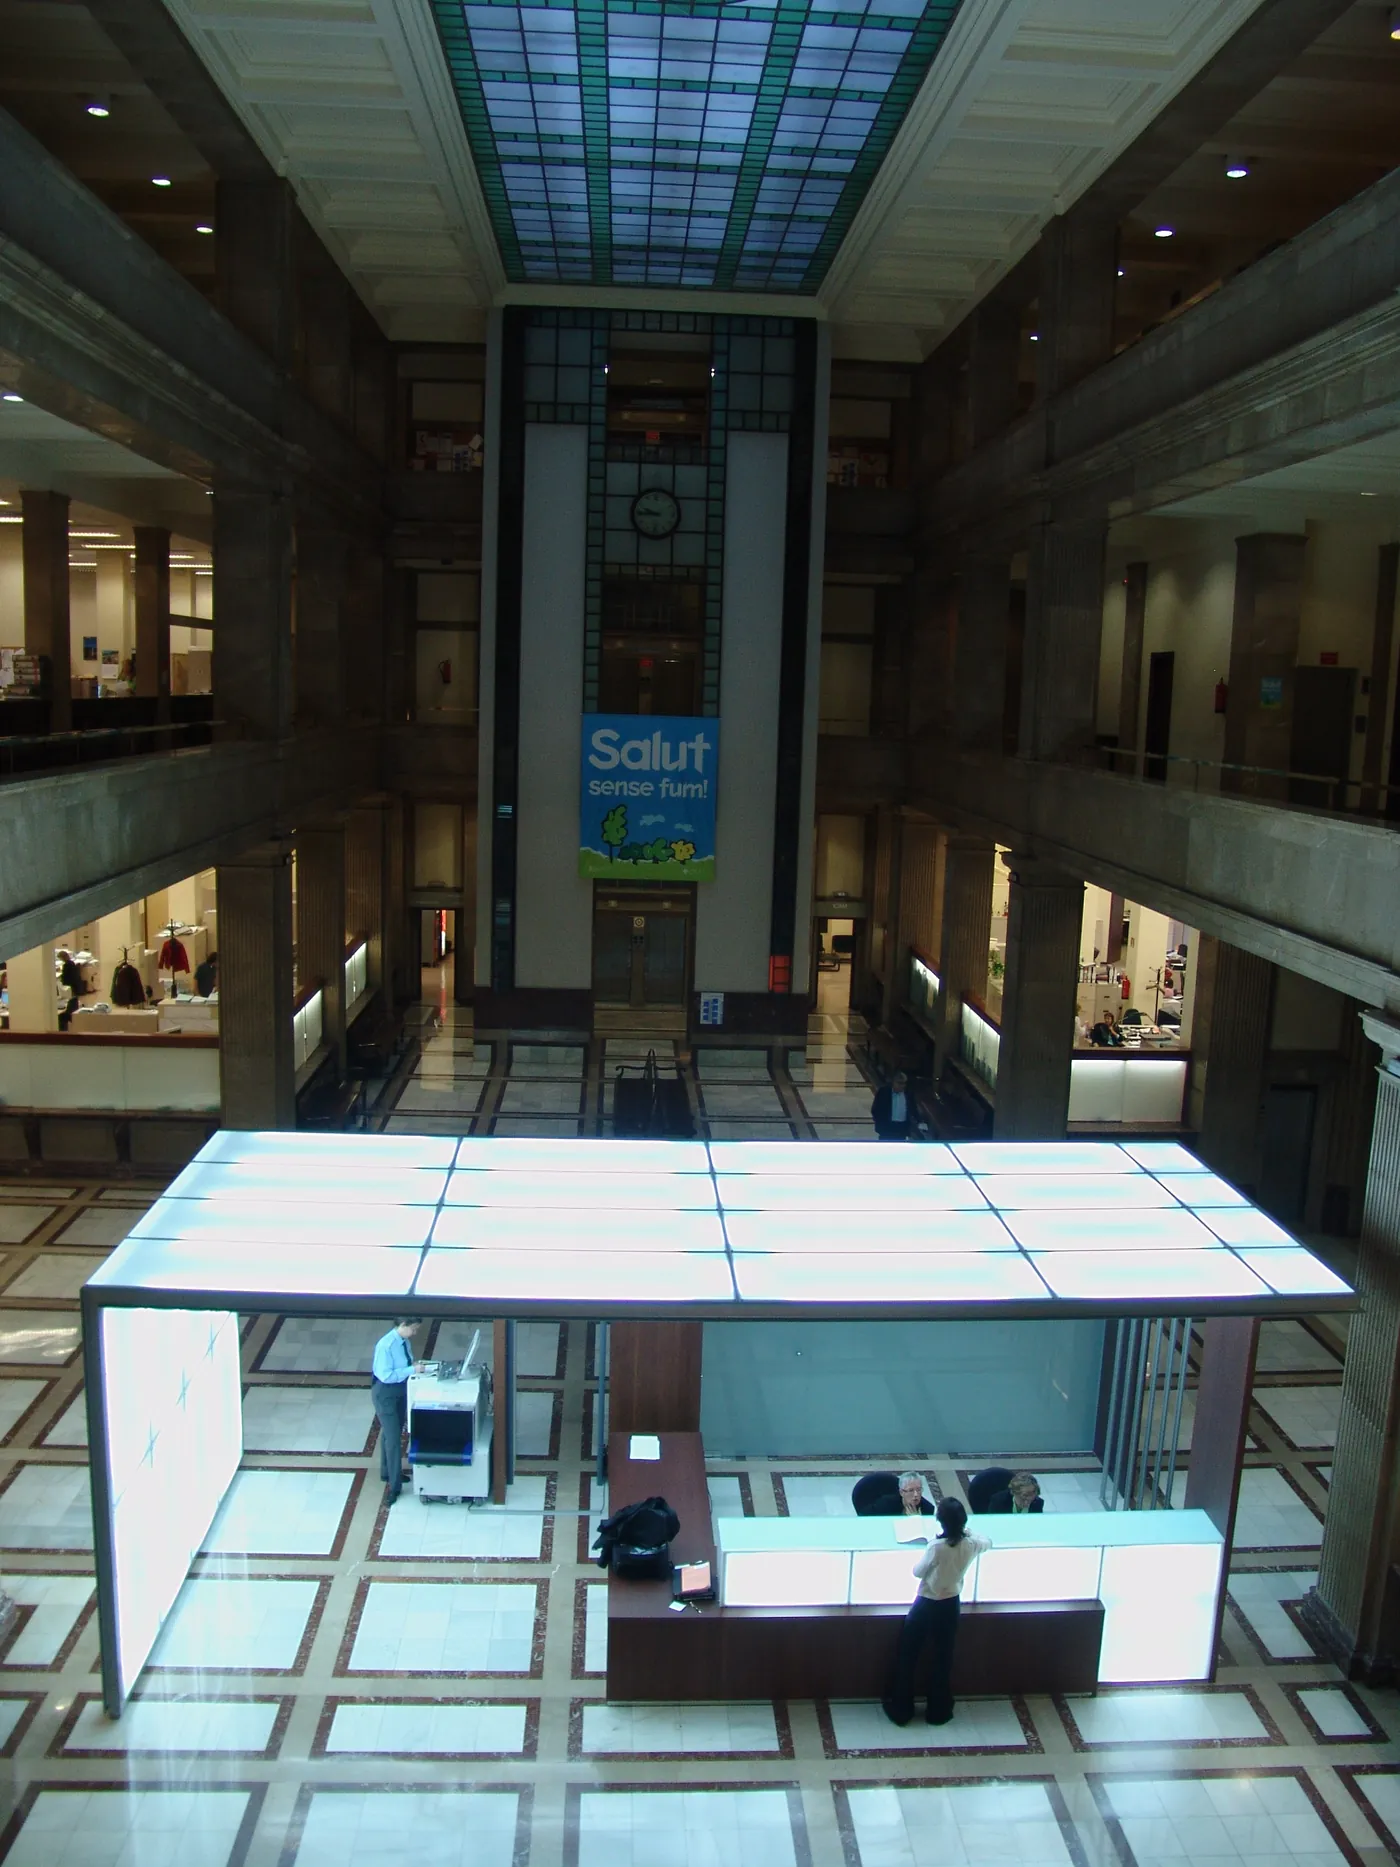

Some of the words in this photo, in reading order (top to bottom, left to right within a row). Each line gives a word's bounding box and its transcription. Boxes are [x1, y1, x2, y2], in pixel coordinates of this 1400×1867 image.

[588, 729, 711, 773] Salut
[589, 779, 654, 797] sense
[659, 778, 708, 799] fum!
